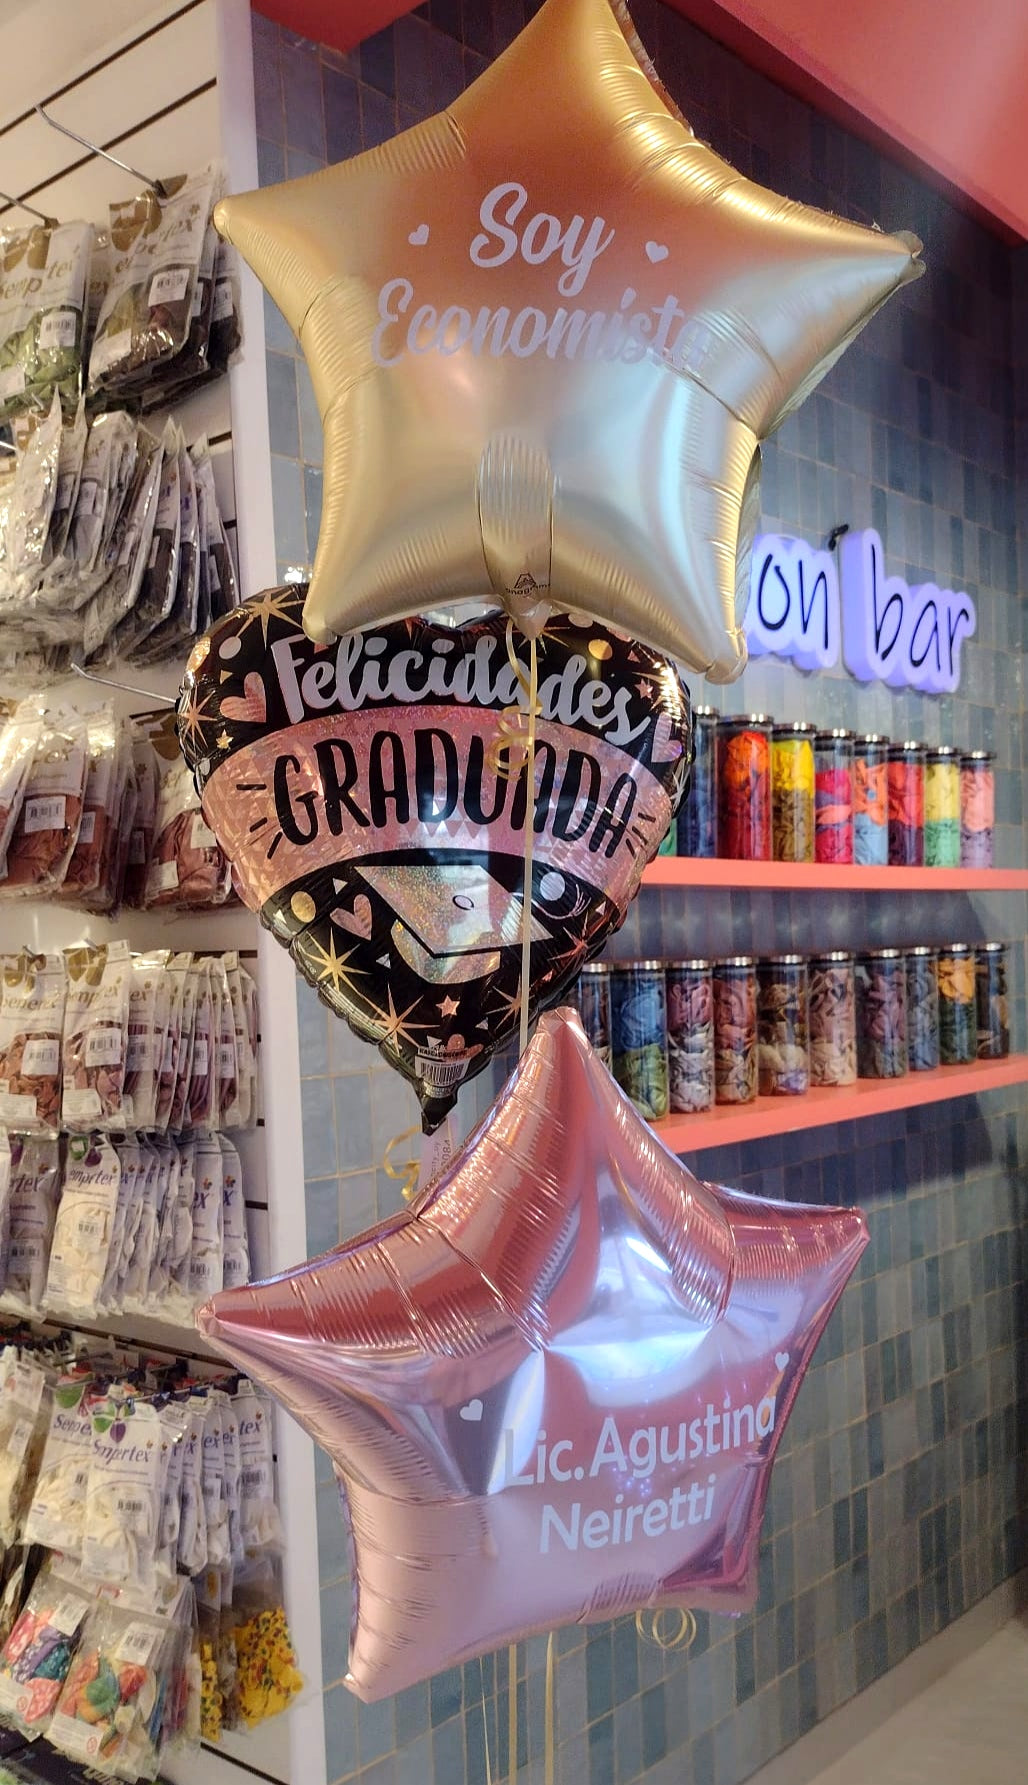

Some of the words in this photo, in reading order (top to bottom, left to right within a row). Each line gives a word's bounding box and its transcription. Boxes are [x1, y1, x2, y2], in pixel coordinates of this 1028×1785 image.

[469, 181, 616, 297] Soy
[371, 277, 711, 369] Economista
[870, 543, 970, 678] bar
[270, 633, 651, 747] Felicidades
[272, 727, 638, 859] GRADUADA
[538, 1473, 717, 1554] Neiretti
